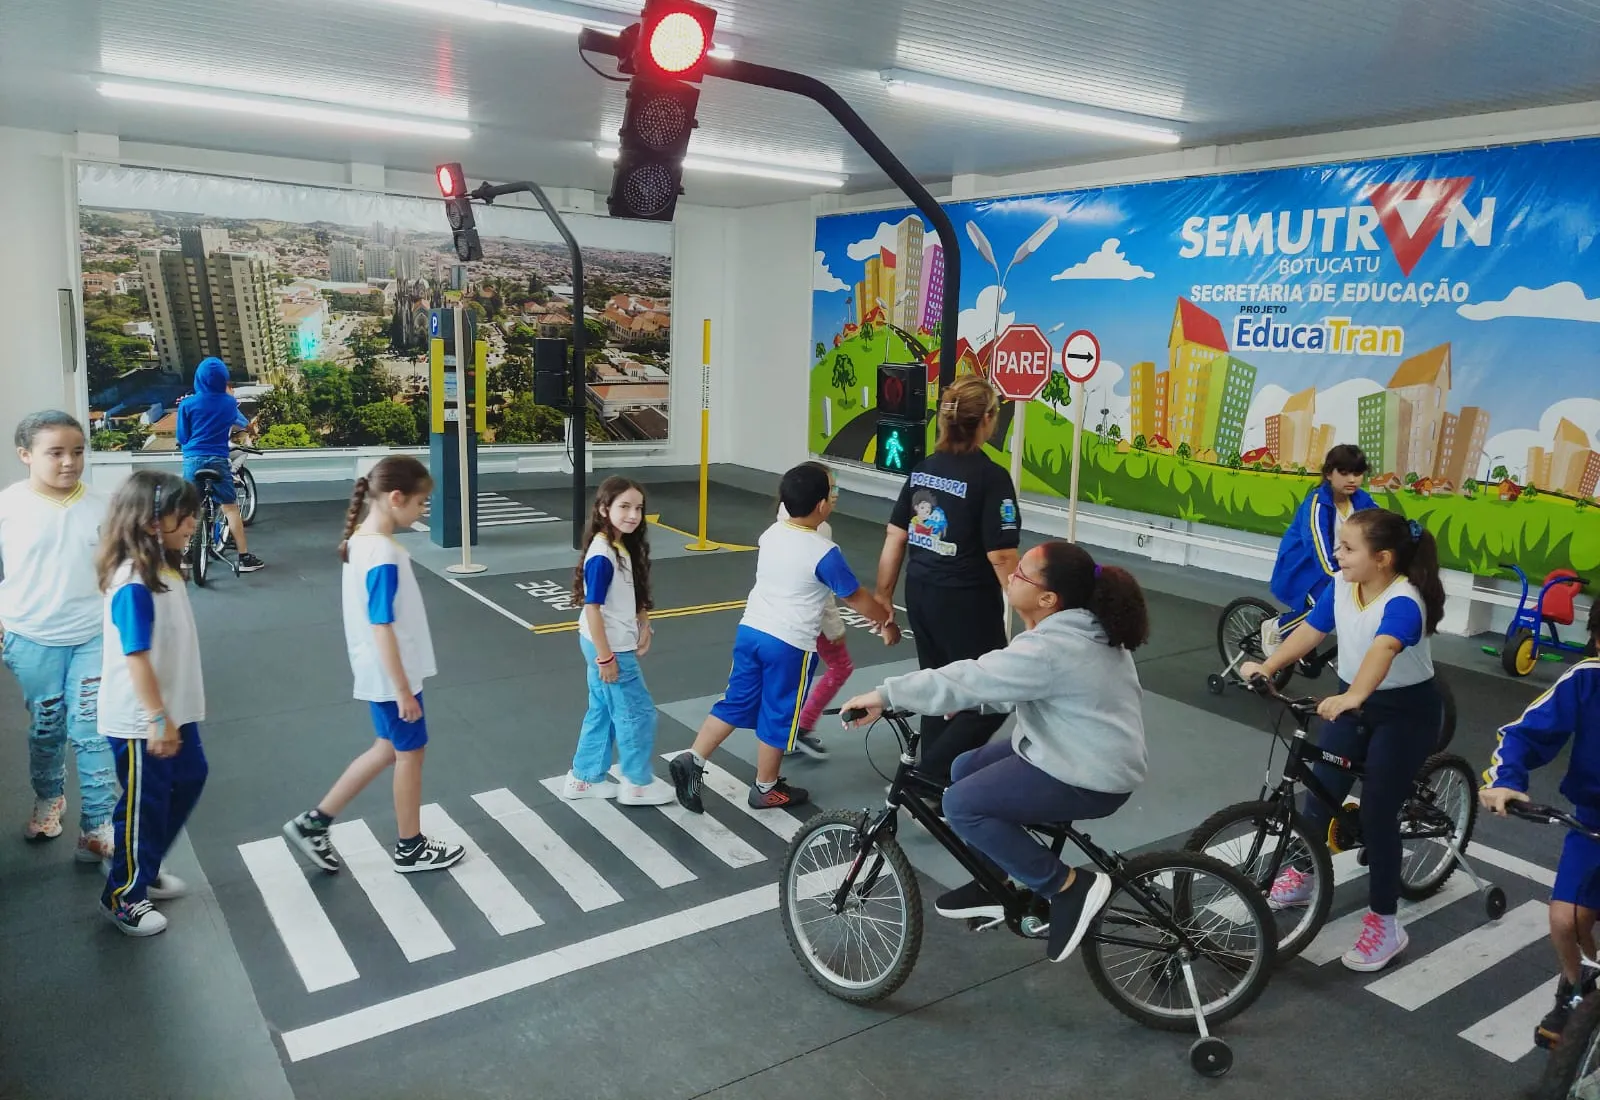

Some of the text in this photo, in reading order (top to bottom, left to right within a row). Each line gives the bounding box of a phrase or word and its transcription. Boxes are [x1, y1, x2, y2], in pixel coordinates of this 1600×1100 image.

[1279, 256, 1381, 276] BOTUCATU
[1190, 277, 1470, 307] SECRETARIA DE EDUCAÇÃO
[1239, 305, 1287, 315] PROJETO
[432, 315, 438, 333] P
[1236, 317, 1403, 354] EducaTran
[996, 350, 1045, 375] PARE
